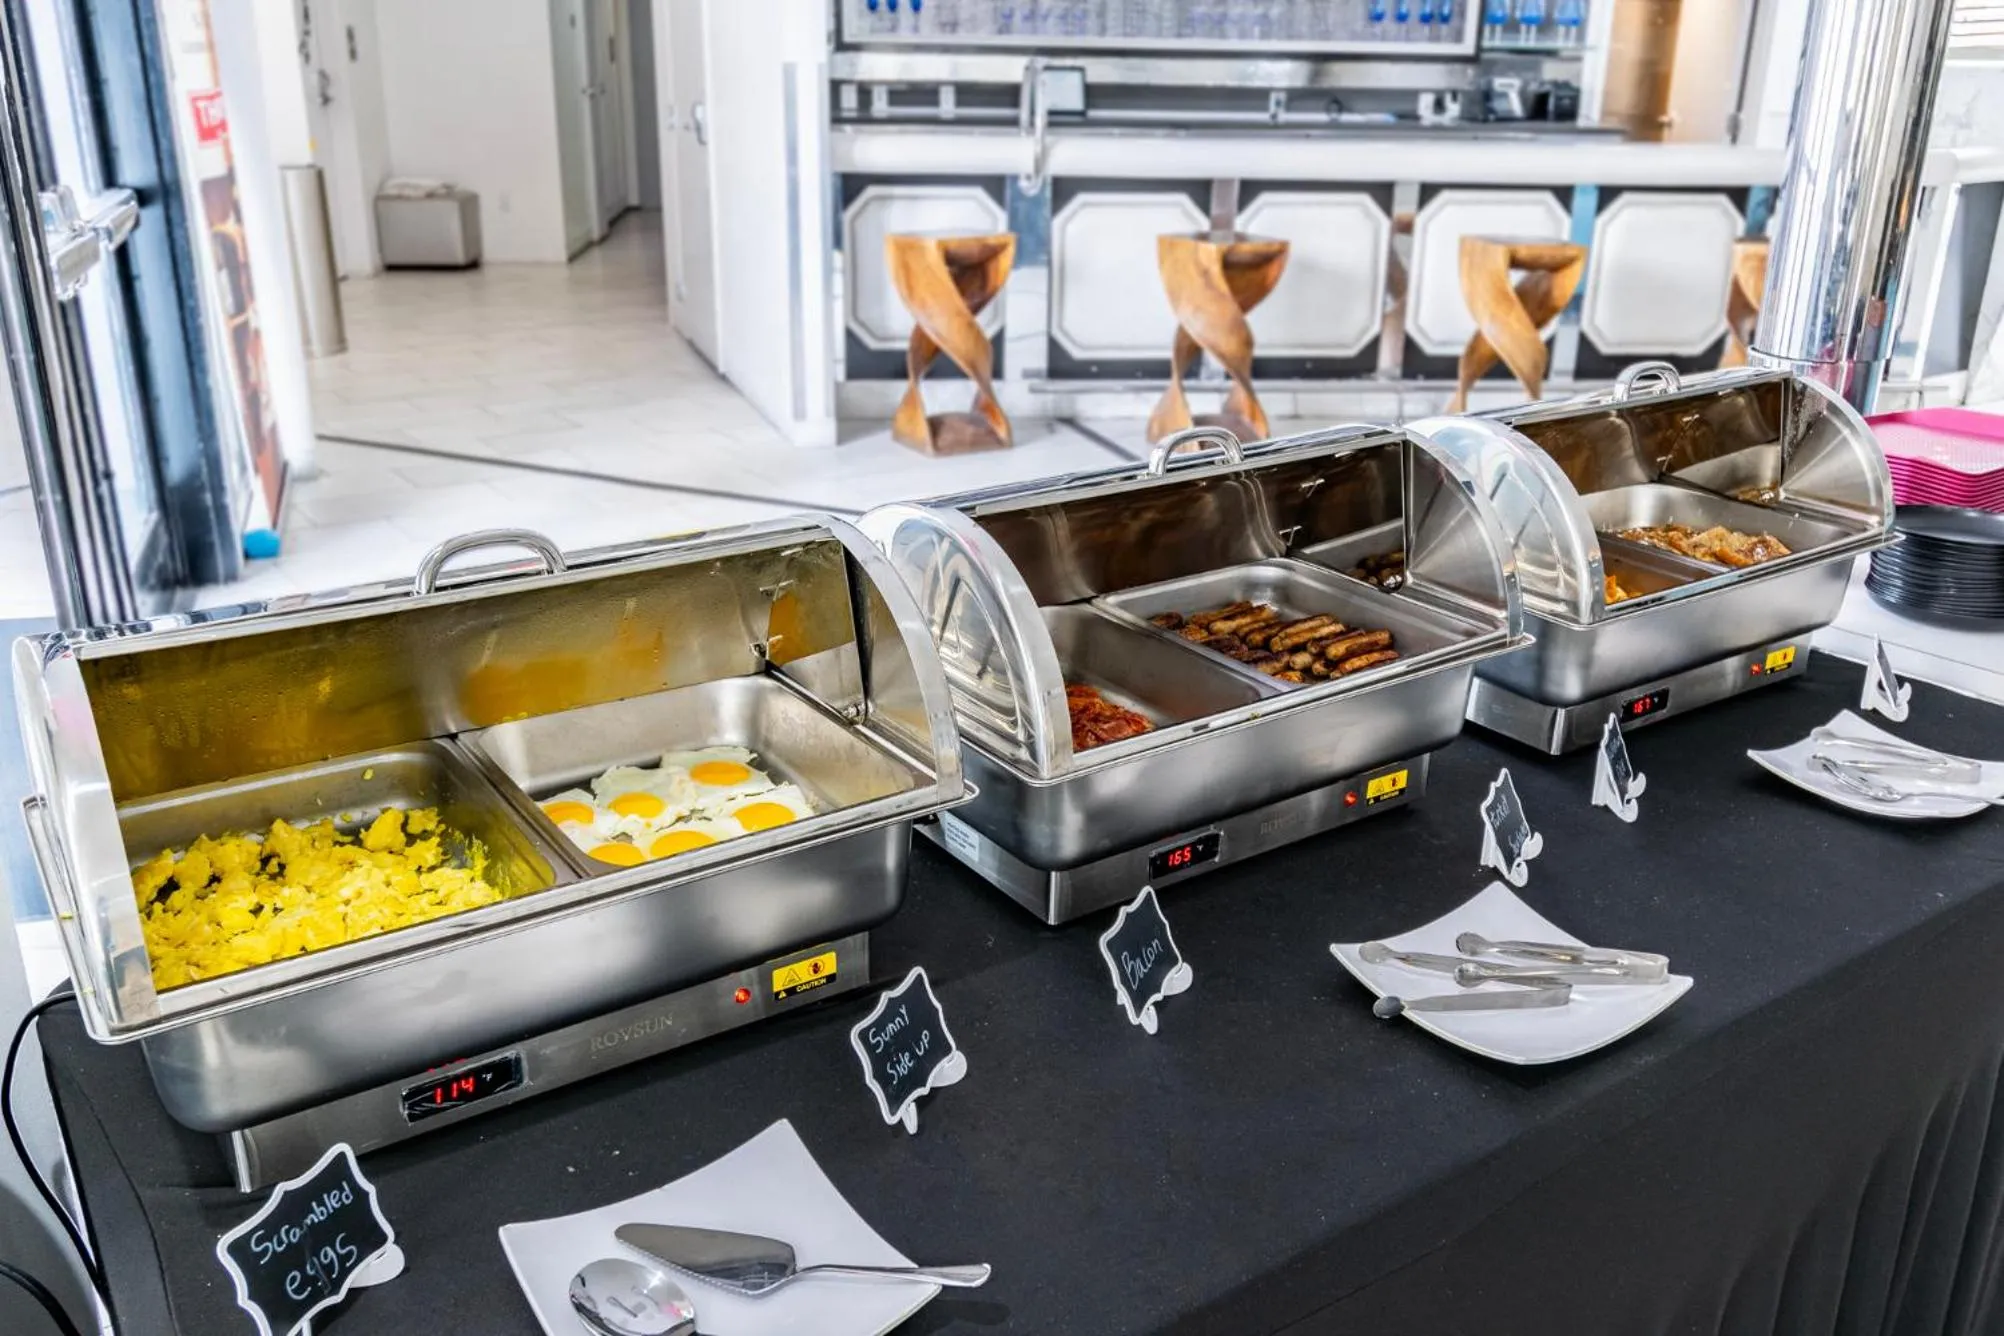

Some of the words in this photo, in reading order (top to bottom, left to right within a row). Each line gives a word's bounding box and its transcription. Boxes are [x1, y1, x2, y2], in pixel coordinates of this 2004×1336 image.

[1168, 847, 1192, 867] 165
[1120, 938, 1163, 990] Bacon
[796, 977, 827, 993] CAUTION
[590, 1013, 673, 1051] ROVSUN
[886, 1050, 914, 1085] Side
[434, 1076, 475, 1105] 114
[250, 1180, 354, 1265] Scrambled
